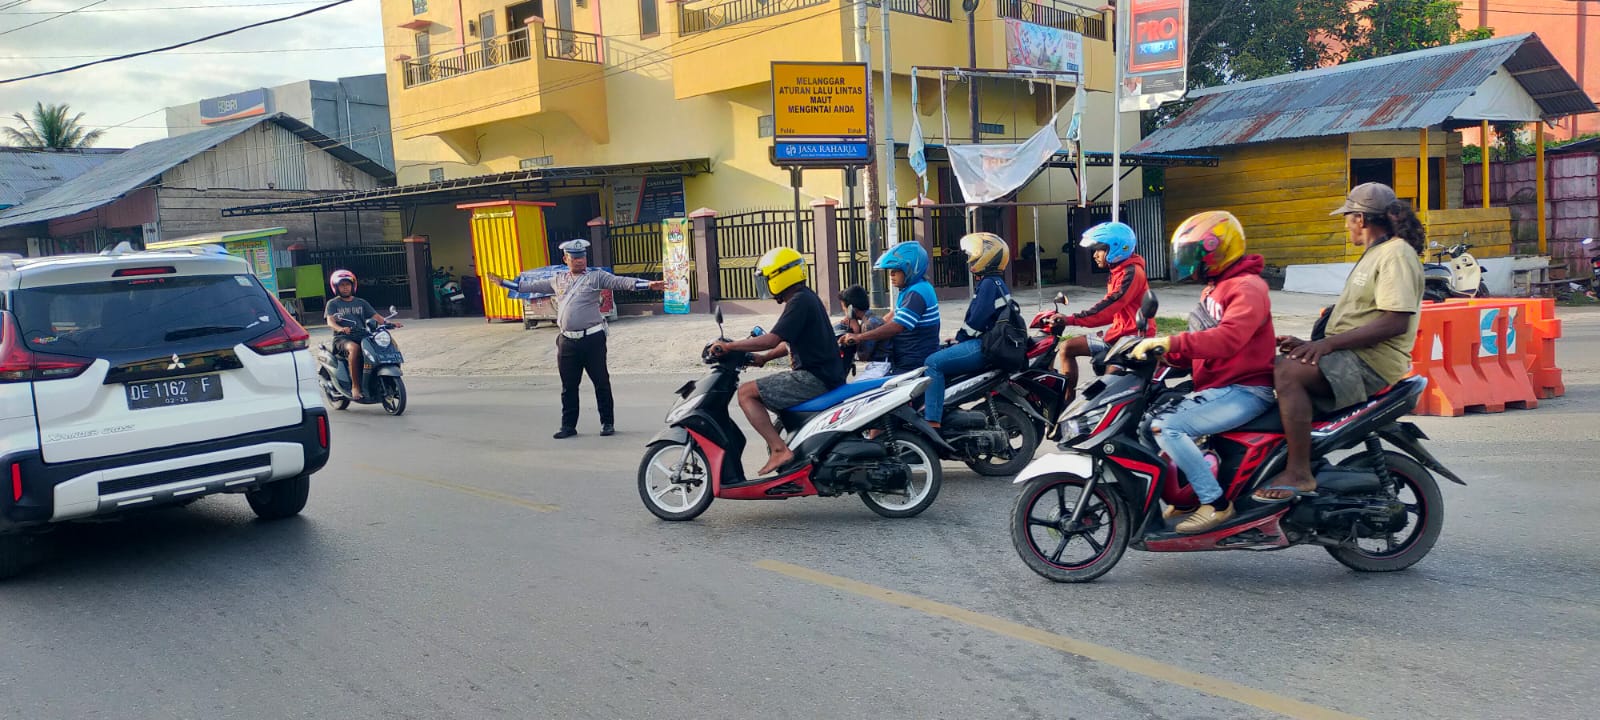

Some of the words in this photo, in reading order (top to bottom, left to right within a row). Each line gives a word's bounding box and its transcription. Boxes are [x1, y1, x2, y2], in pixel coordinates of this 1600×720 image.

[1136, 17, 1178, 42] PRO
[796, 77, 845, 85] MELANGGAR
[810, 96, 832, 104] MAUT
[799, 145, 817, 153] JASA
[819, 145, 857, 153] RAHARJA
[131, 385, 149, 400] DE
[155, 381, 187, 397] 1162
[201, 378, 209, 392] F
